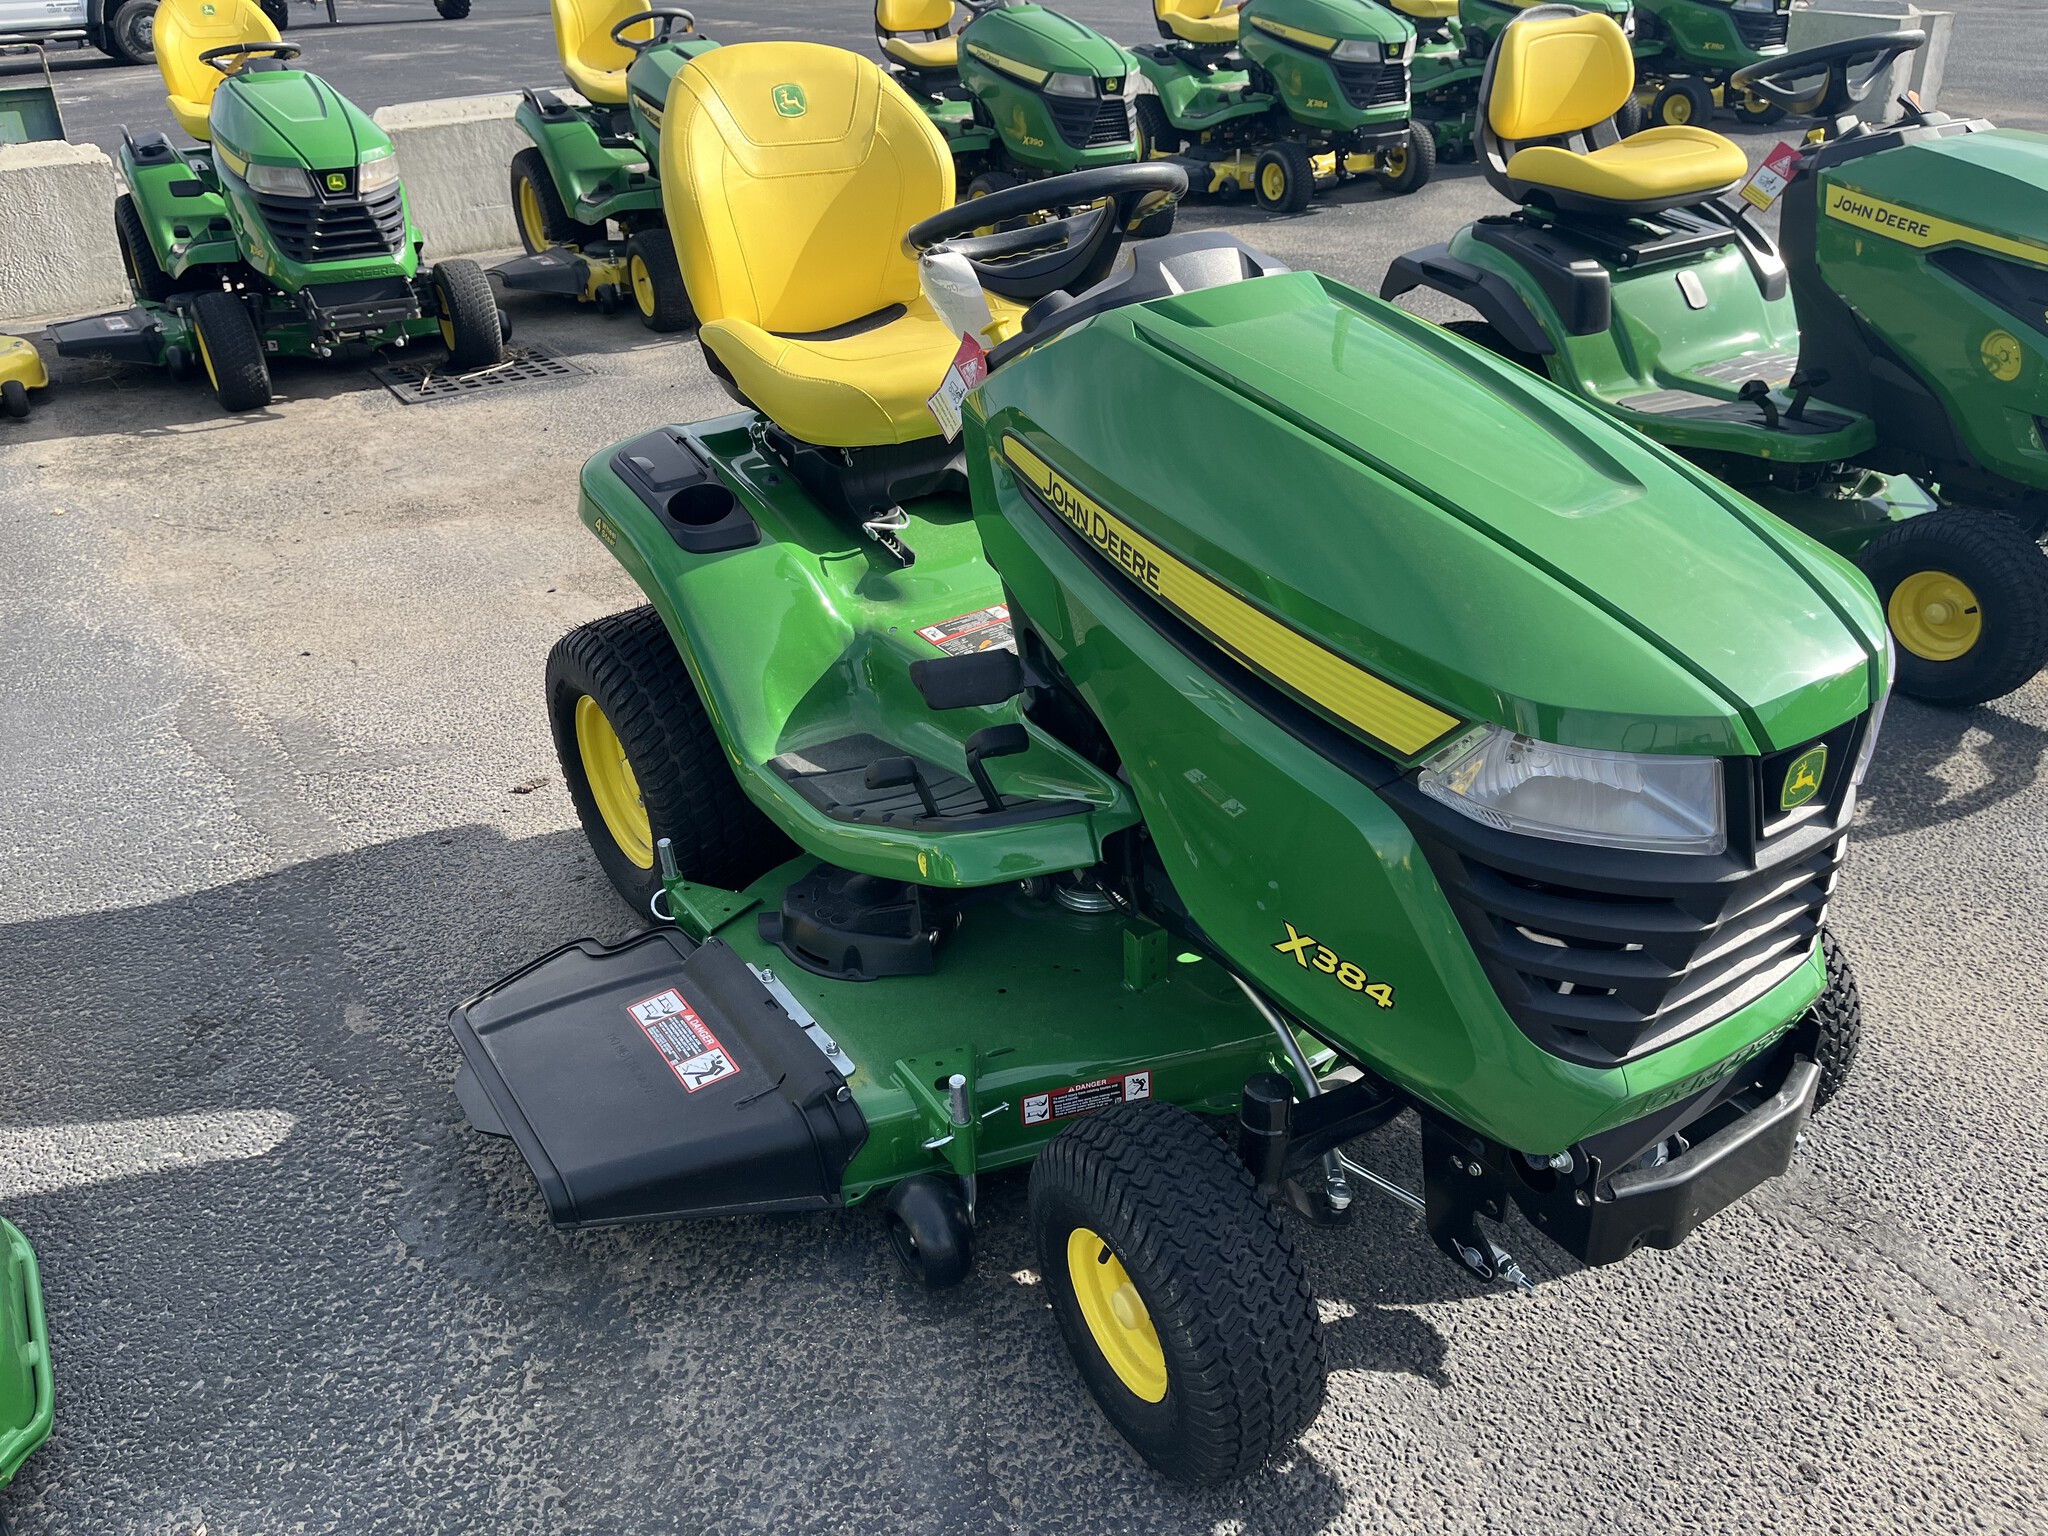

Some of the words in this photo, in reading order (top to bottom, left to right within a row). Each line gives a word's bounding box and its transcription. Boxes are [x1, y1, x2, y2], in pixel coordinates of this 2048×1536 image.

[1833, 196, 1872, 220] JOHN
[1875, 209, 1930, 237] DEERE
[1043, 472, 1089, 532] JOHN
[1093, 511, 1161, 592] DEERE
[1272, 920, 1395, 1009] X384
[690, 1020, 715, 1046] DANGER
[1076, 1079, 1107, 1091] DANGER
